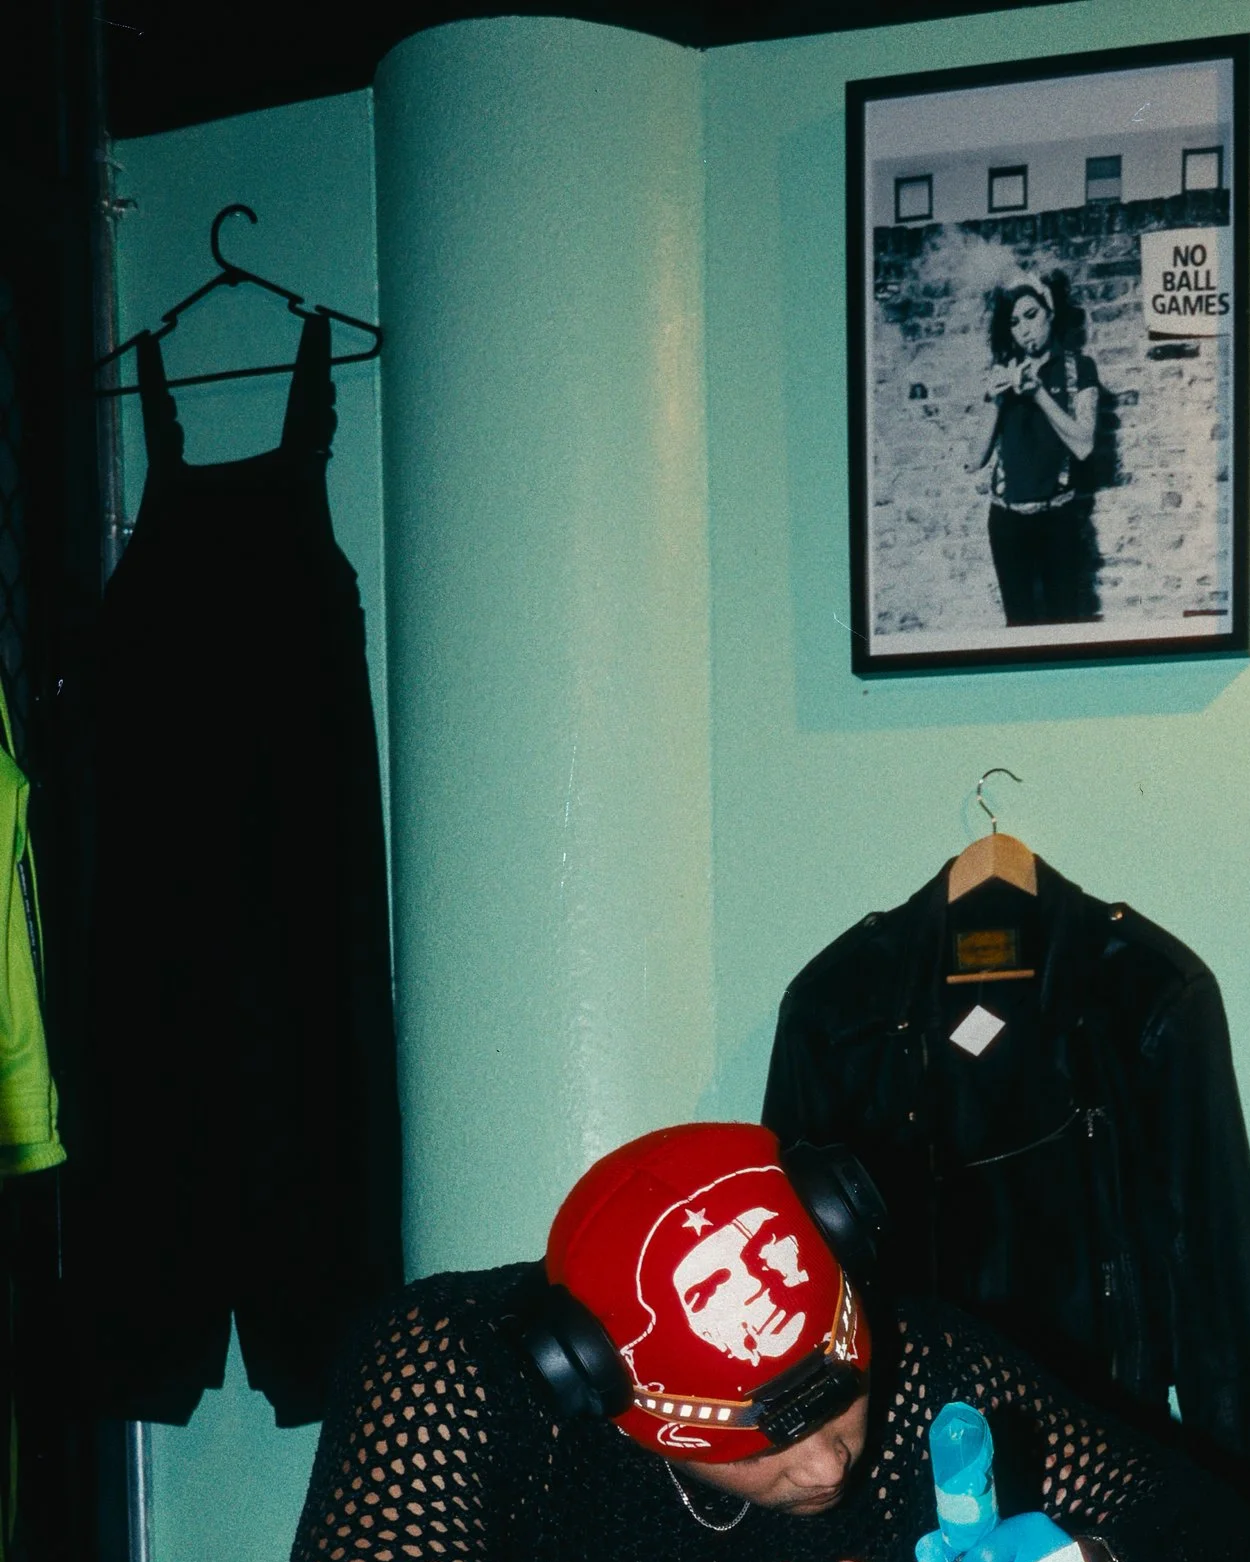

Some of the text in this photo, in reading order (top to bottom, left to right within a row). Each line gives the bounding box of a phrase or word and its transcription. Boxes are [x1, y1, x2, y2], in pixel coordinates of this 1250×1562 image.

[1172, 244, 1208, 268] NO
[1162, 269, 1217, 292] BALL
[1151, 292, 1231, 316] GAMES
